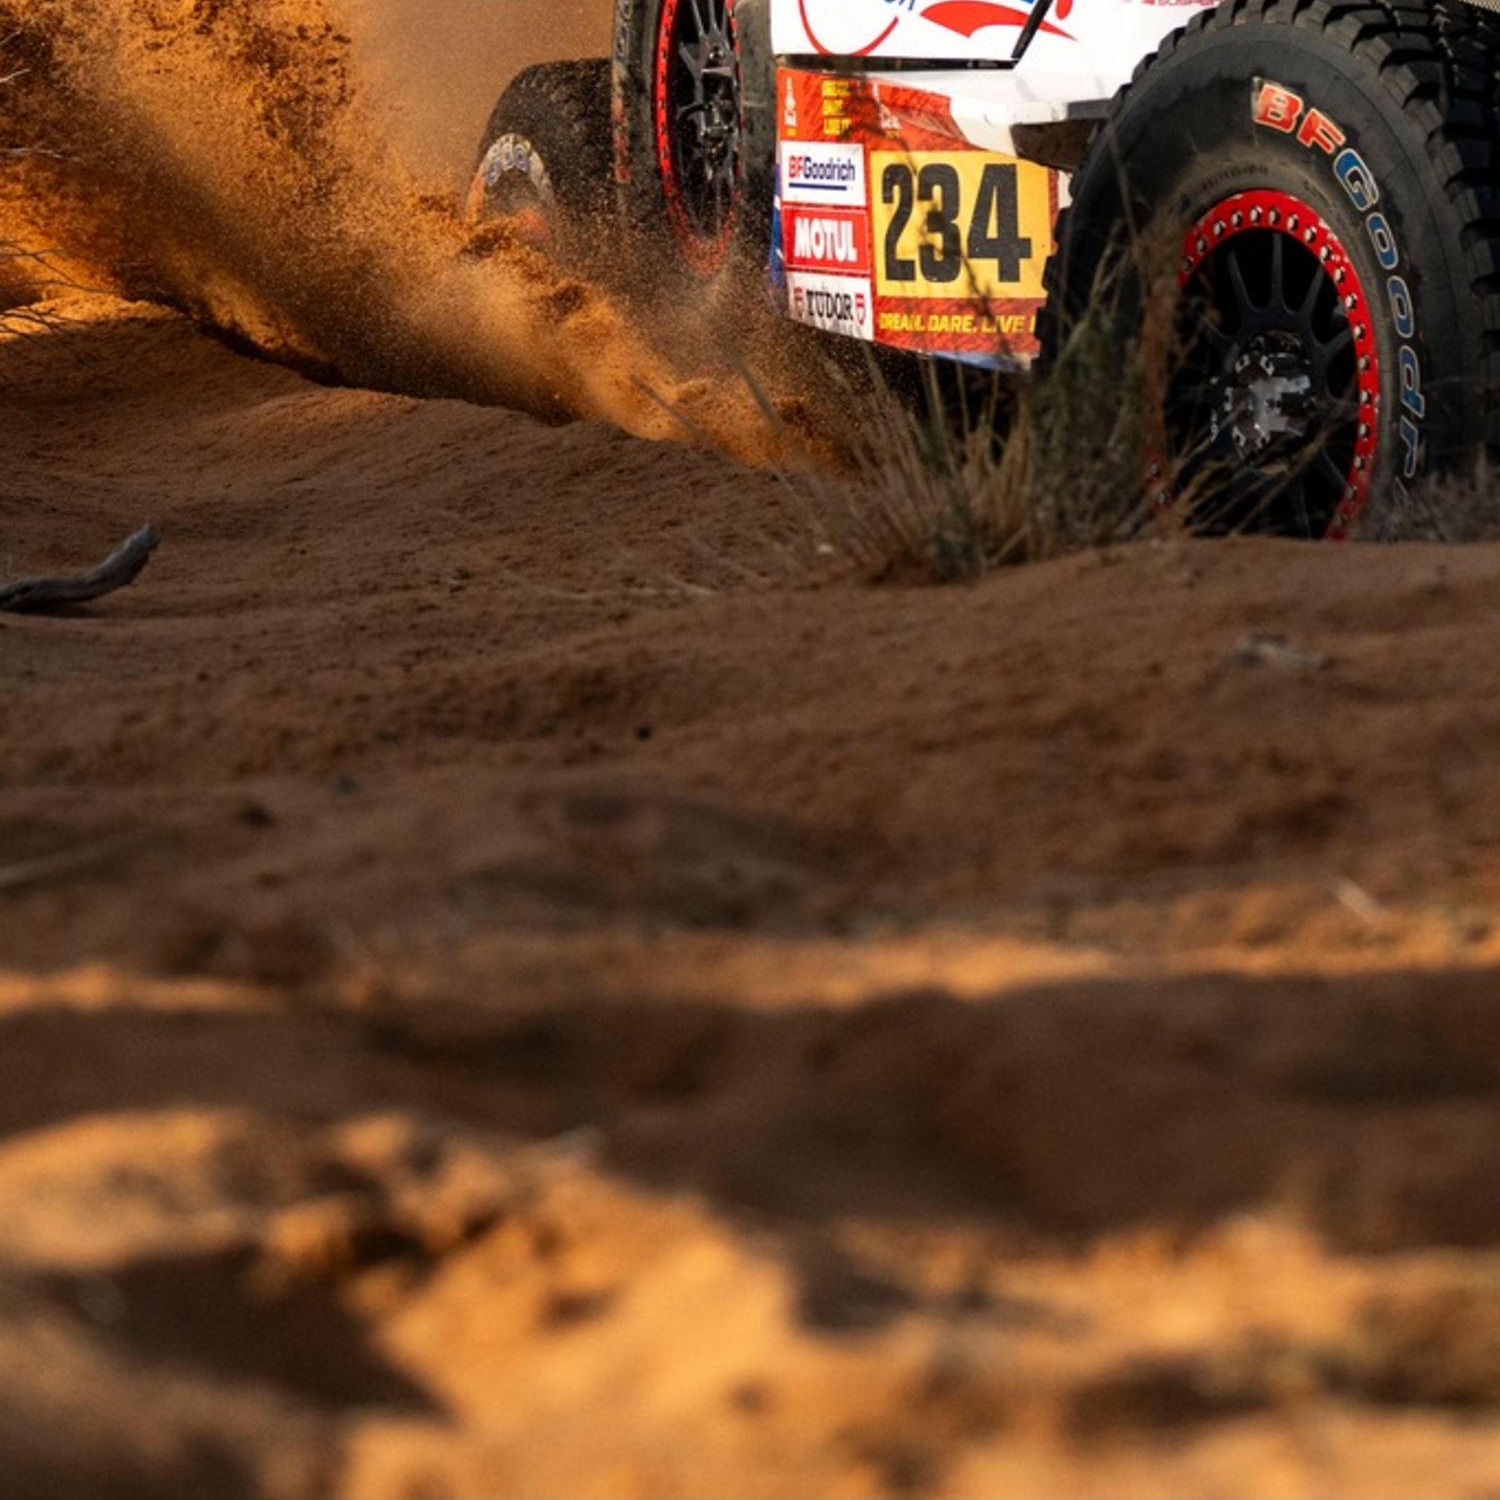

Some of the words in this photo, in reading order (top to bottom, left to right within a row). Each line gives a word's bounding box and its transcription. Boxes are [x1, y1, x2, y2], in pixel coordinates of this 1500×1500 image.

[788, 156, 855, 182] BFGoodrich
[794, 218, 858, 262] MOTUL
[881, 163, 1032, 283] 234
[1252, 80, 1425, 490] BFGoodr
[806, 289, 853, 320] TUDOR
[880, 313, 925, 331] DREAM.
[928, 314, 977, 333] DARE.
